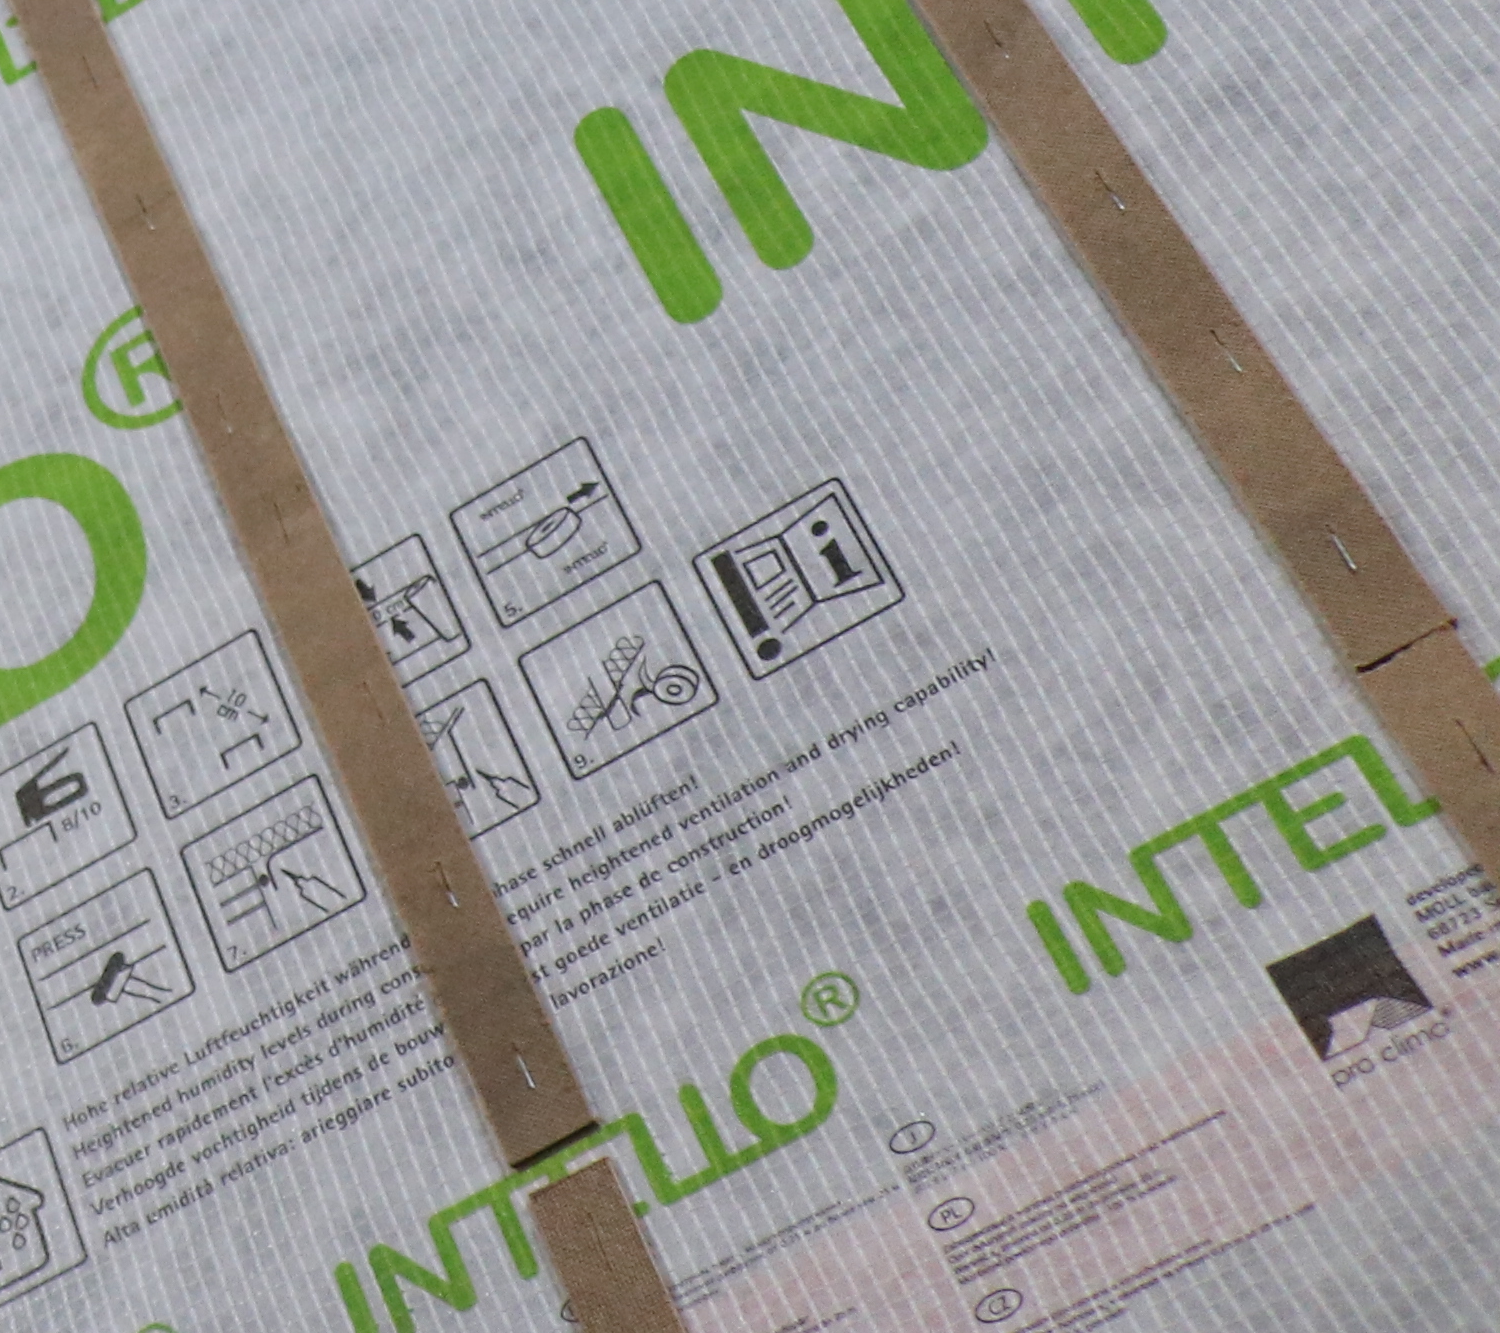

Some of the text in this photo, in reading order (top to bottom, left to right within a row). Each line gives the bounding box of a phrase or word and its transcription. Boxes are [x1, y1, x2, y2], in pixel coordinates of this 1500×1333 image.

[542, 824, 607, 872] schnell
[567, 647, 996, 892] heightened ventilation and drying capability!
[553, 917, 575, 935] la
[578, 884, 634, 926] phase
[638, 869, 663, 890] de
[666, 794, 793, 874] construction!
[554, 739, 962, 975] goede ventilatie en droogmogelijkheden!
[29, 924, 88, 963] PRESS
[549, 936, 667, 1010] lavorazione!
[61, 930, 418, 1132] Hohe relative Luftfeuchtigkeit während
[71, 990, 376, 1161] Heightened humidity levels during
[88, 1052, 391, 1216] Verhoogde vochtigheid tijdens de
[104, 1220, 141, 1248] Alta
[300, 1087, 393, 1144] arieggiare
[397, 1049, 459, 1093] subito
[156, 1085, 259, 1149] rapidement
